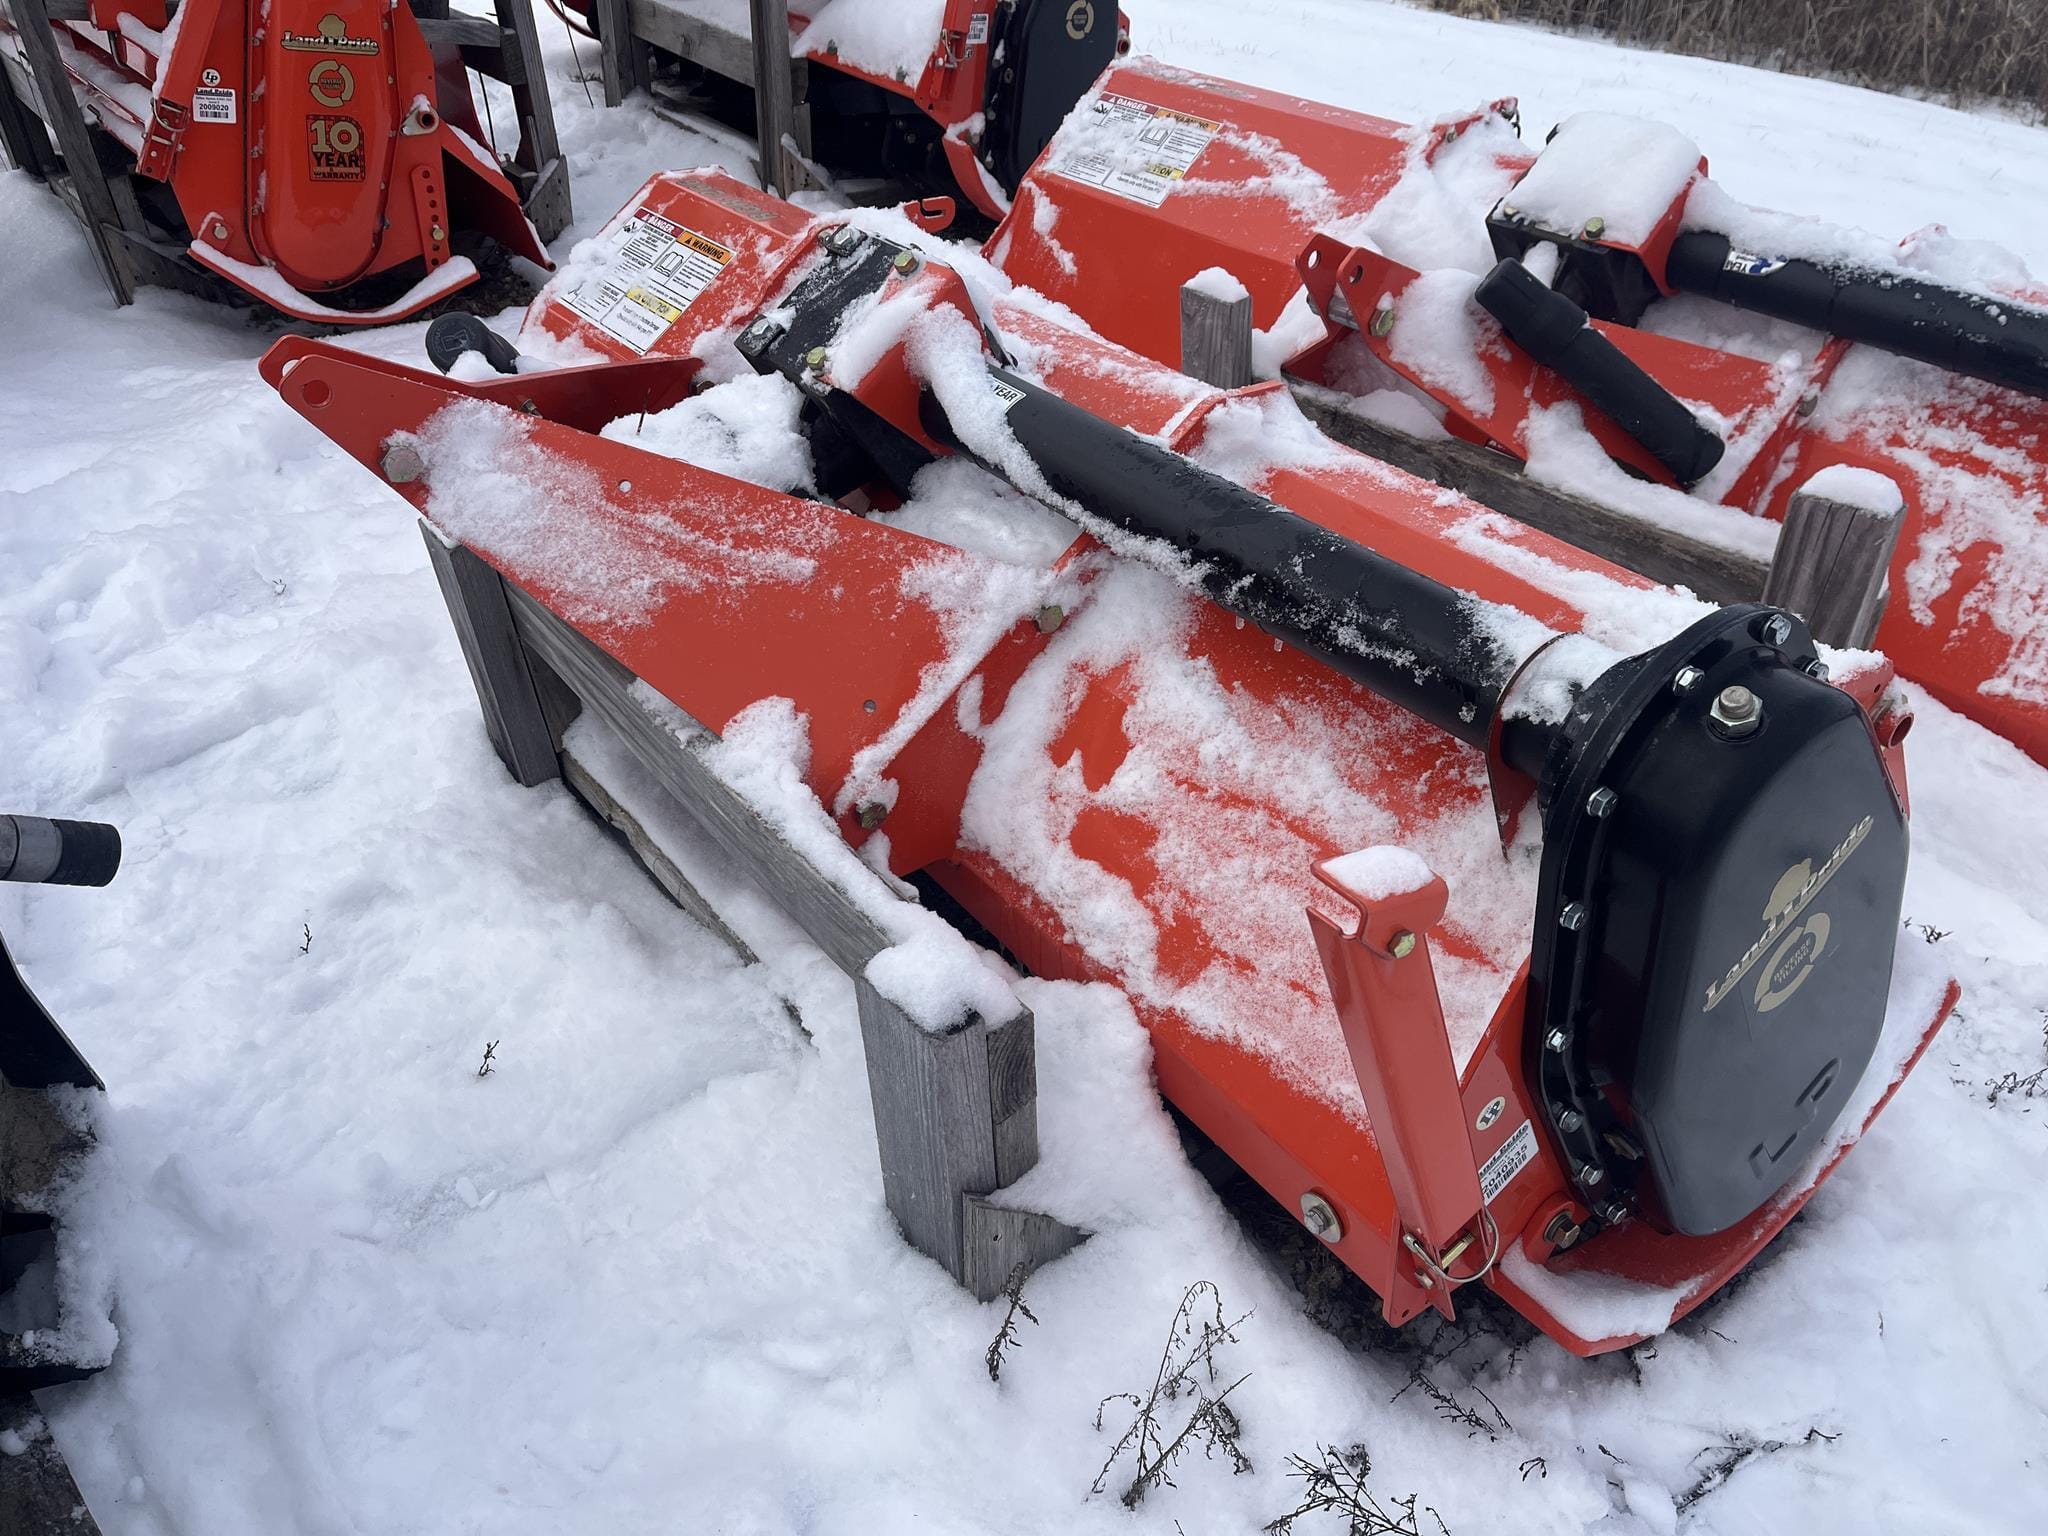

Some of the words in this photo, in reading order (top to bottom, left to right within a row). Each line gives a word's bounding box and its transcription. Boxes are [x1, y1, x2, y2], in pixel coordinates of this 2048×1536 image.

[284, 31, 325, 48] Land
[337, 36, 378, 50] Pride
[205, 71, 218, 83] LP
[195, 88, 212, 96] Land
[1116, 98, 1148, 111] DANGER
[311, 119, 360, 153] 10
[312, 152, 360, 168] YEAR
[313, 171, 360, 180] WARRANTY
[648, 213, 675, 234] DANGER
[692, 239, 725, 260] WARNING
[993, 384, 1018, 402] YEAR
[1704, 908, 1786, 1010] Land
[1798, 815, 1874, 902] Pride
[1480, 1100, 1500, 1125] LP
[1483, 1143, 1528, 1193] 2040935
